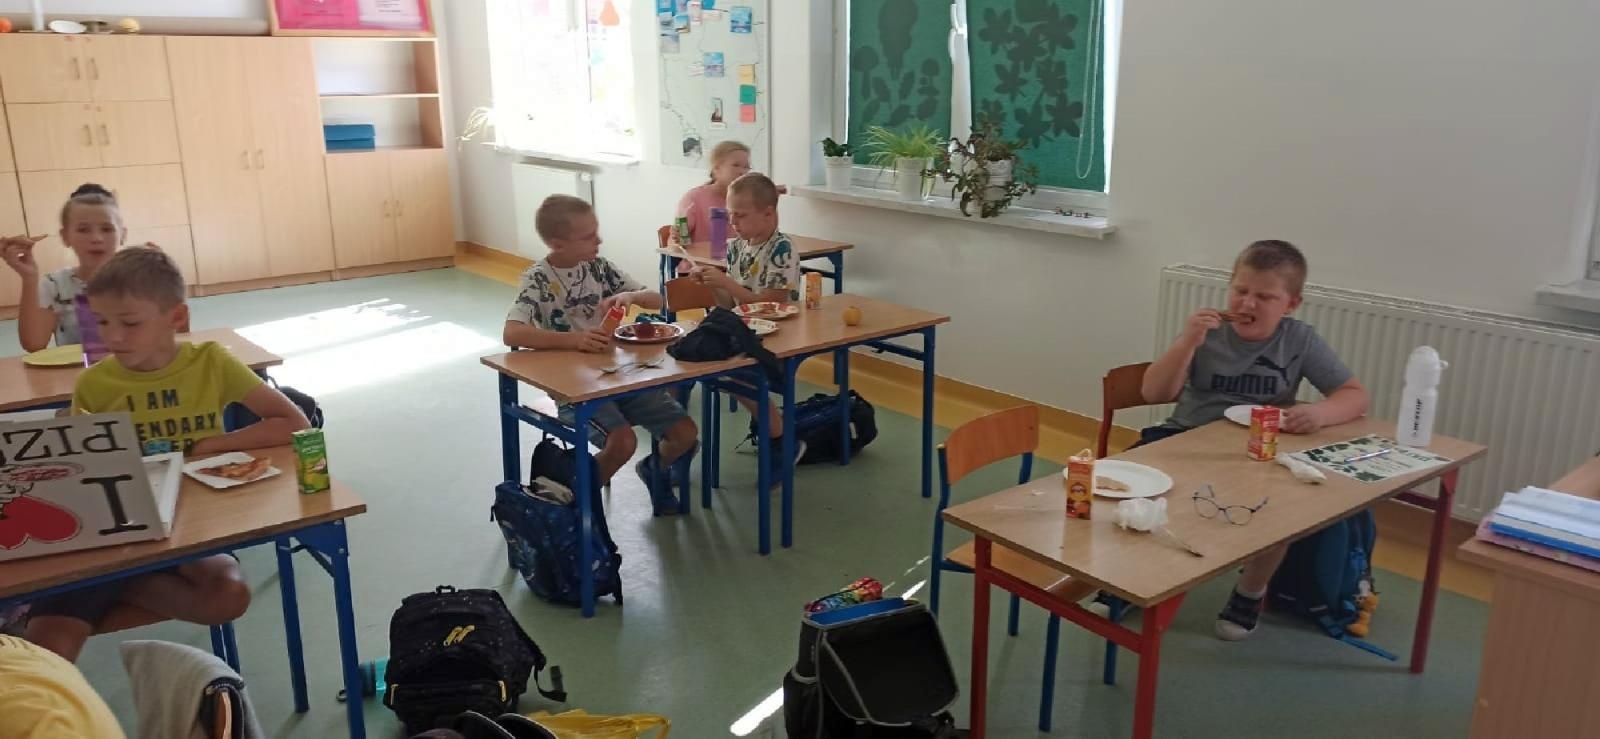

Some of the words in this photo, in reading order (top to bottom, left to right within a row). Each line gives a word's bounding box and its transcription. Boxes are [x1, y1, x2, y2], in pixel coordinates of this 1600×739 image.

[1211, 373, 1277, 395] PUMA
[126, 395, 135, 412] I
[147, 389, 179, 410] AM
[135, 412, 216, 441] ENDARY
[1, 421, 128, 462] PIZ
[81, 474, 148, 536] I
